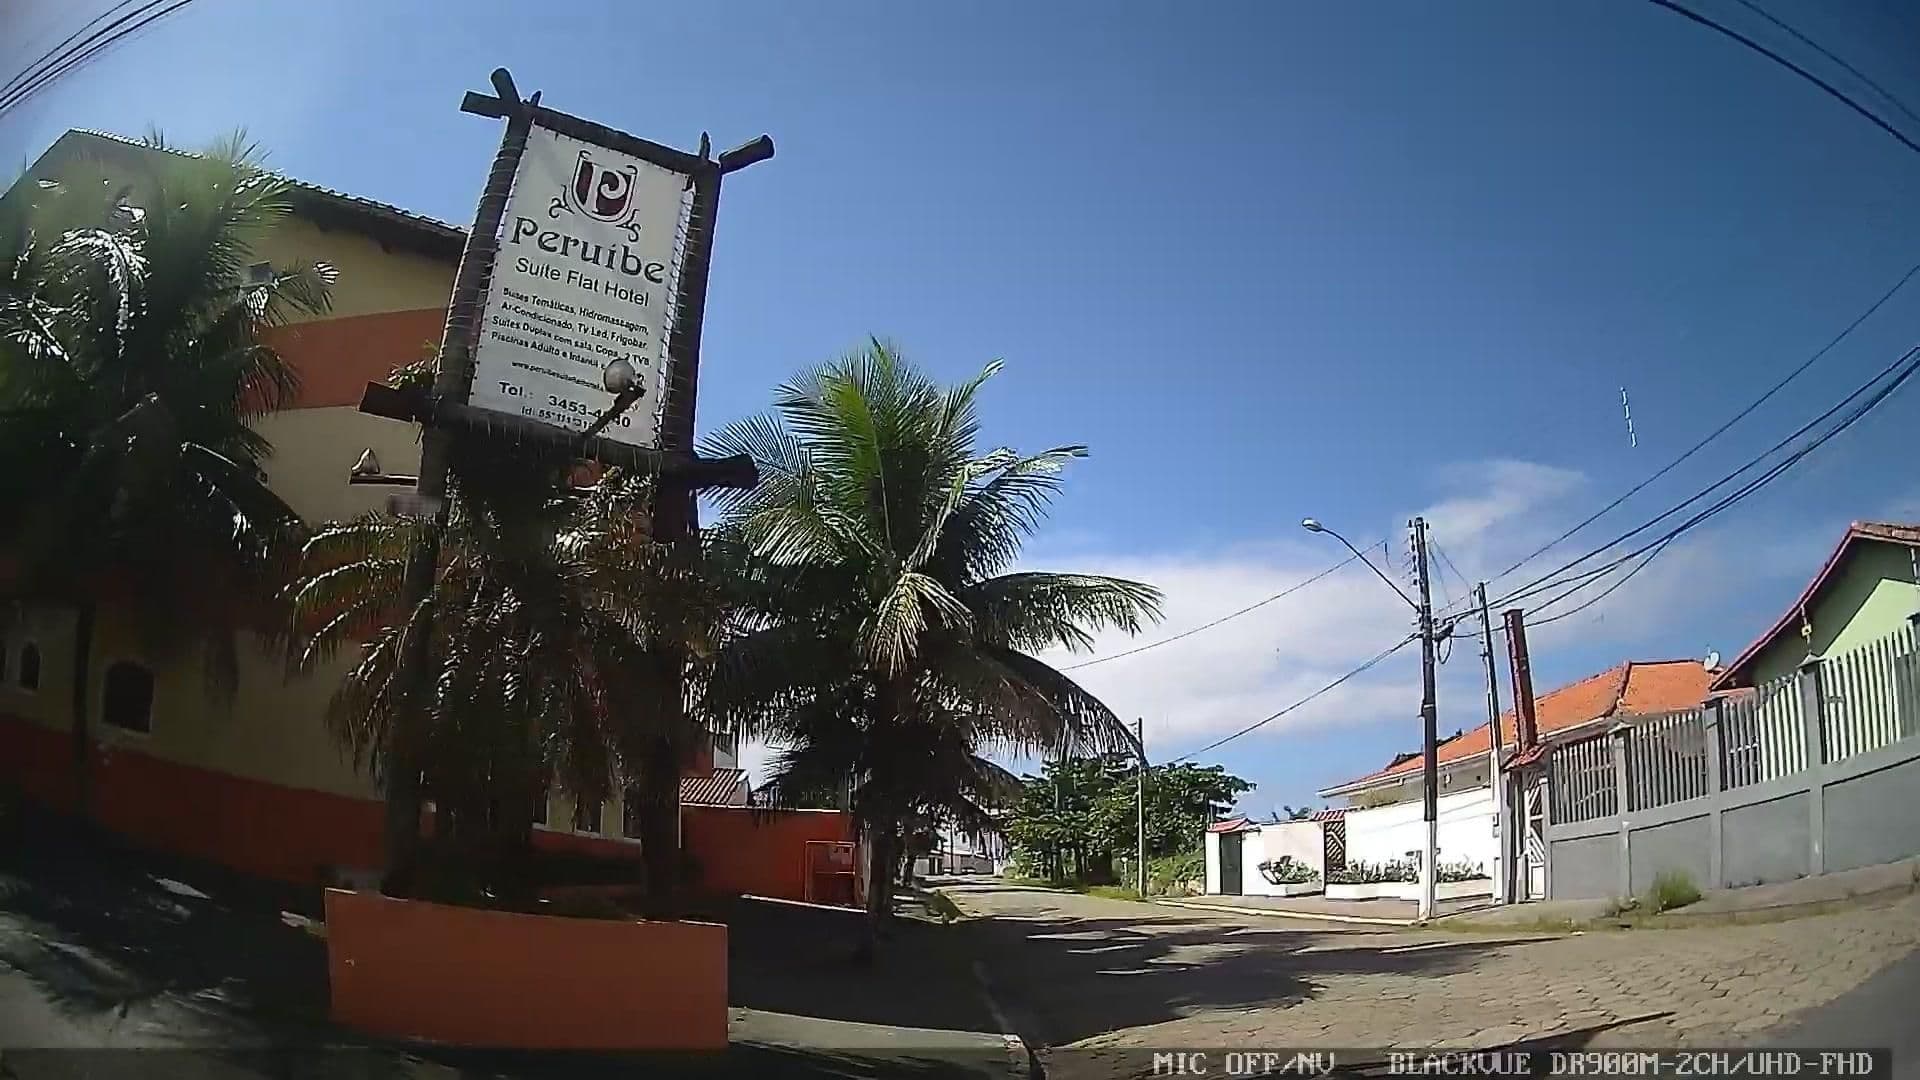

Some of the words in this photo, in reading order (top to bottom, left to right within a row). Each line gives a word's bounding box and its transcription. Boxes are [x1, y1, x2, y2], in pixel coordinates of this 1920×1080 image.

[567, 269, 599, 293] Flat
[604, 281, 650, 307] Hotel
[491, 330, 529, 348] Piscinas
[530, 340, 560, 356] Adulto
[553, 335, 573, 346] com
